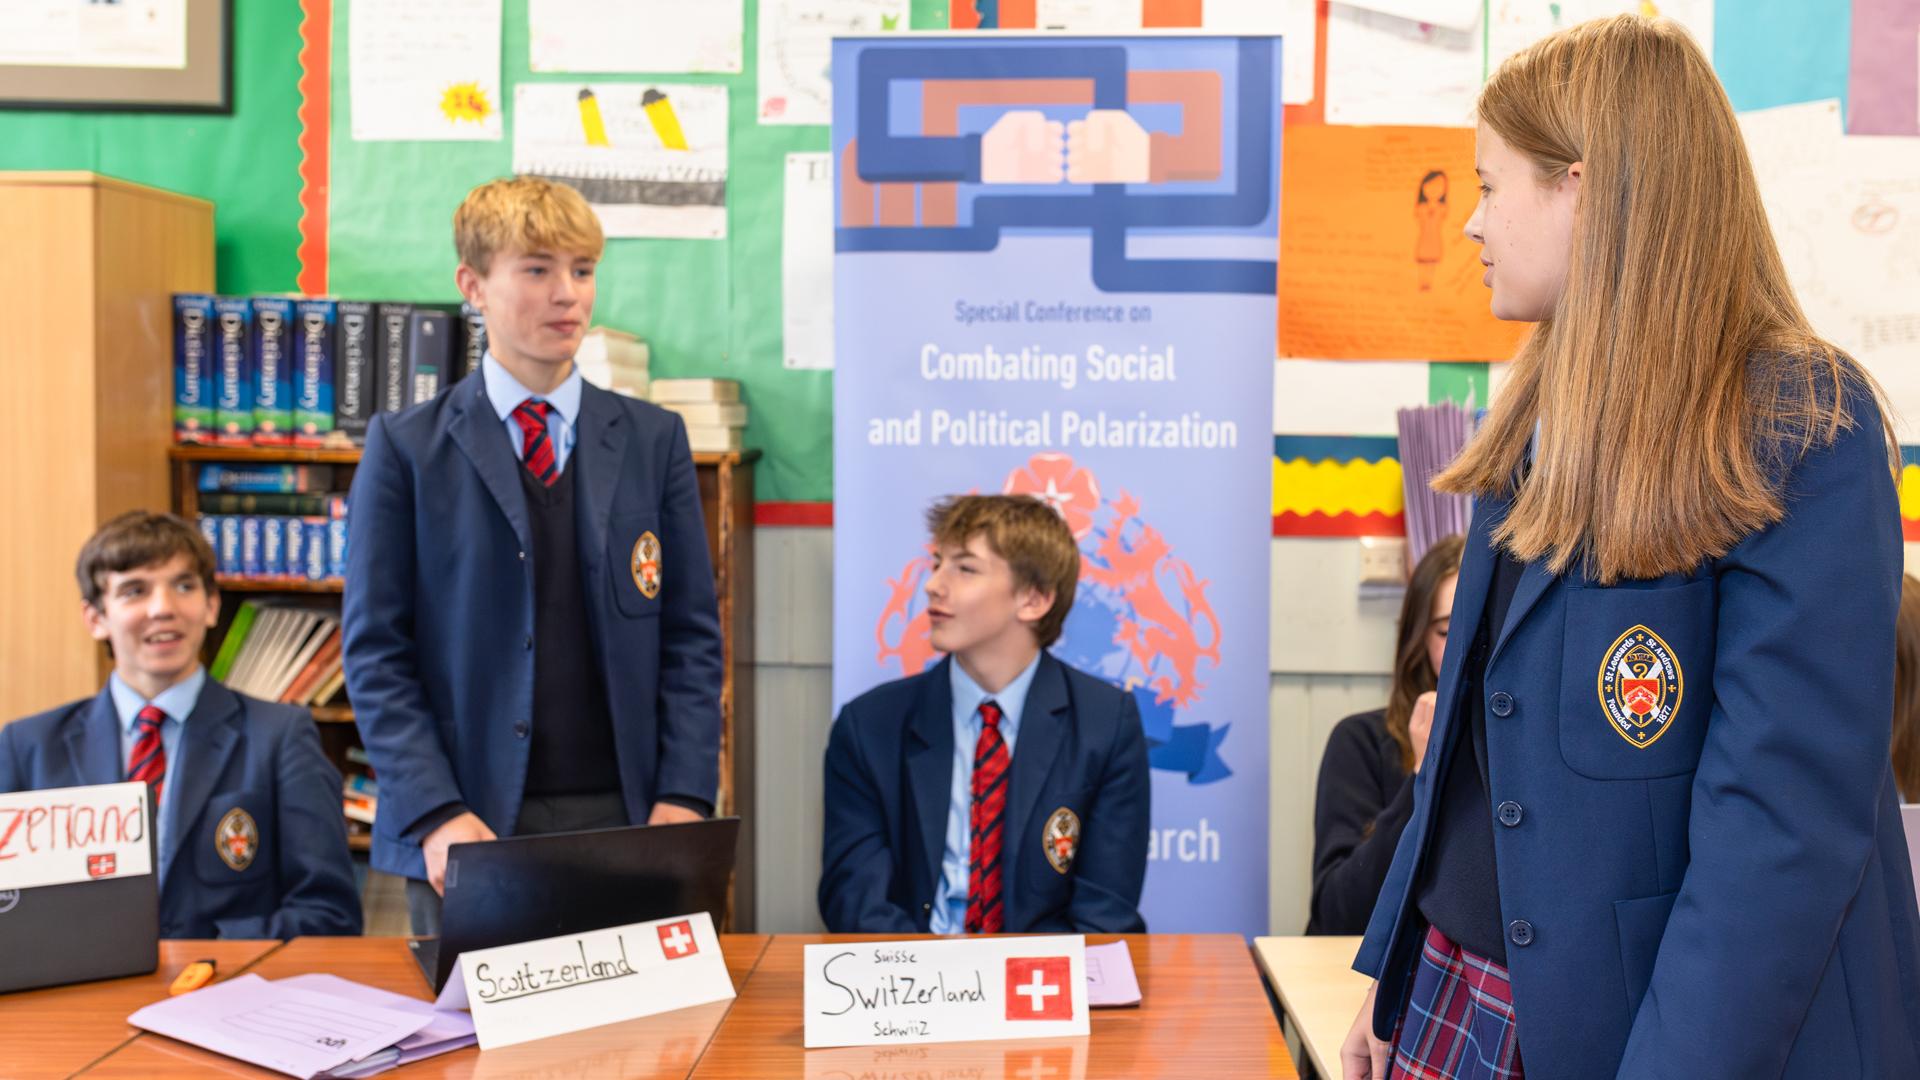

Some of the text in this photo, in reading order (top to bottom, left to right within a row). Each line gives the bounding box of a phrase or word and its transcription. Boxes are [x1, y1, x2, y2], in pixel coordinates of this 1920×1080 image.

[954, 300, 1152, 326] Special Conference on
[920, 343, 1176, 389] Combating Social
[868, 409, 1237, 448] and Political Polarization
[1607, 637, 1636, 672] Leonards
[1645, 638, 1675, 681] St Andrews
[1606, 698, 1672, 731] Founded 1877
[476, 935, 638, 999] Switzerland
